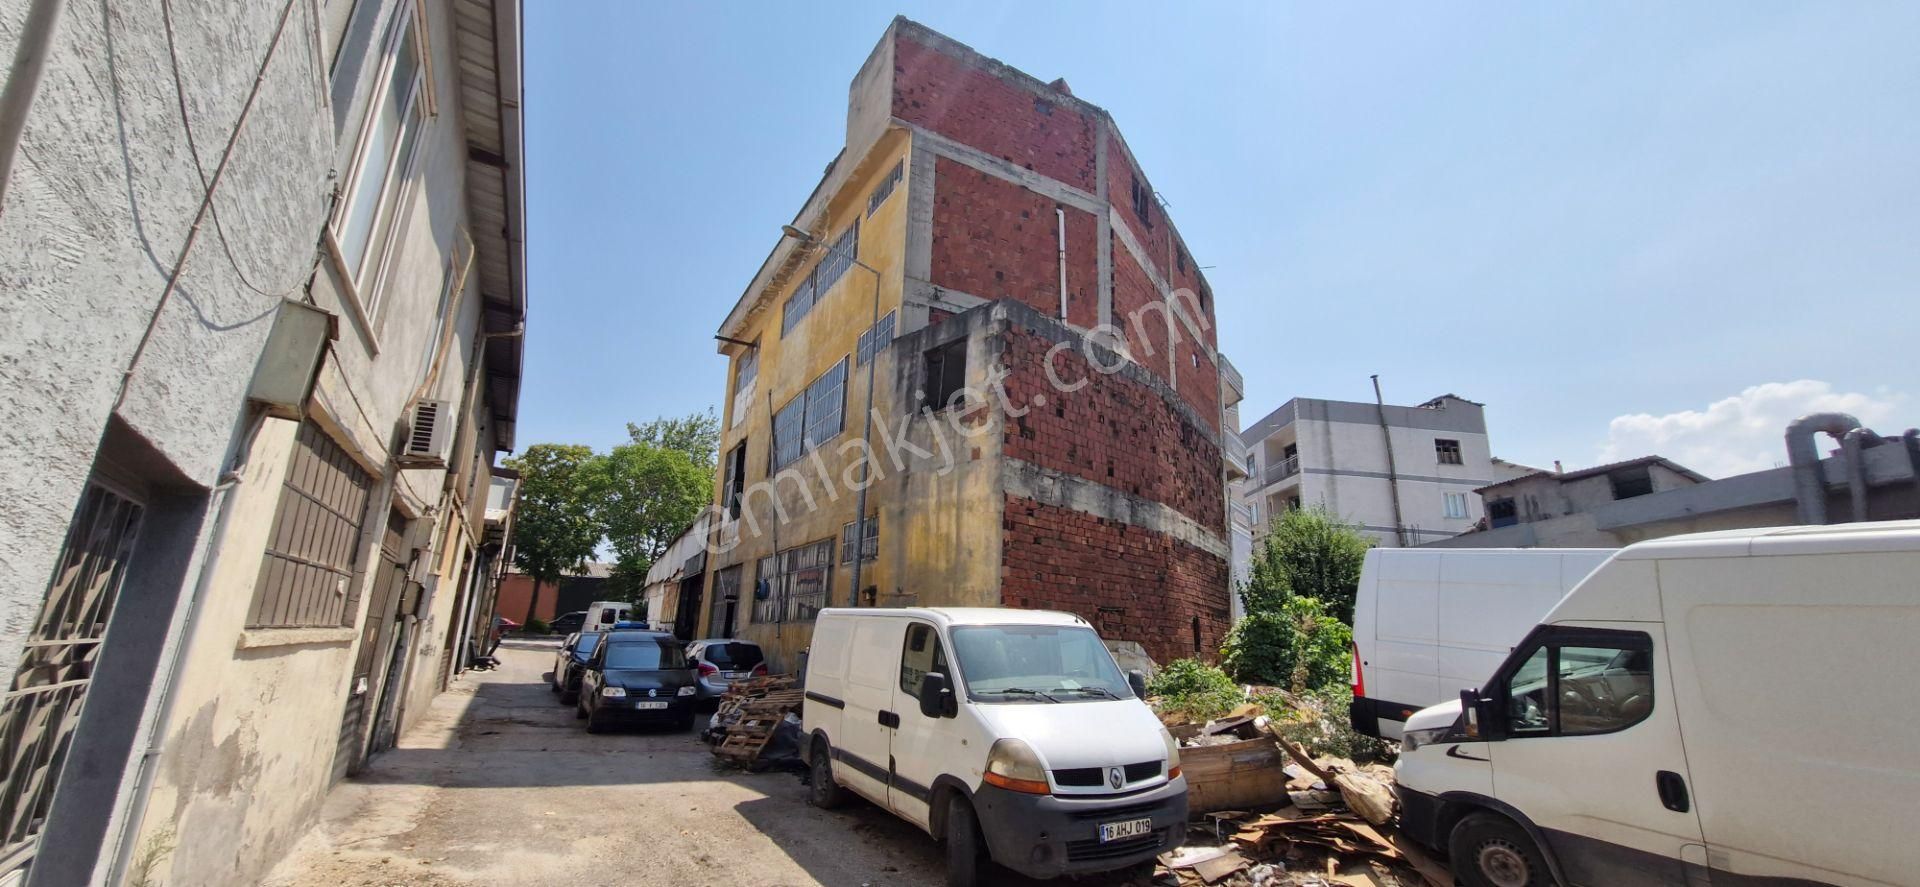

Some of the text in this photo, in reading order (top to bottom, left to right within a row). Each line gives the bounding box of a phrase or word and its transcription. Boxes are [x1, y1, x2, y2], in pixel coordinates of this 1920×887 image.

[1105, 820, 1150, 840] 16 AHJ 019
